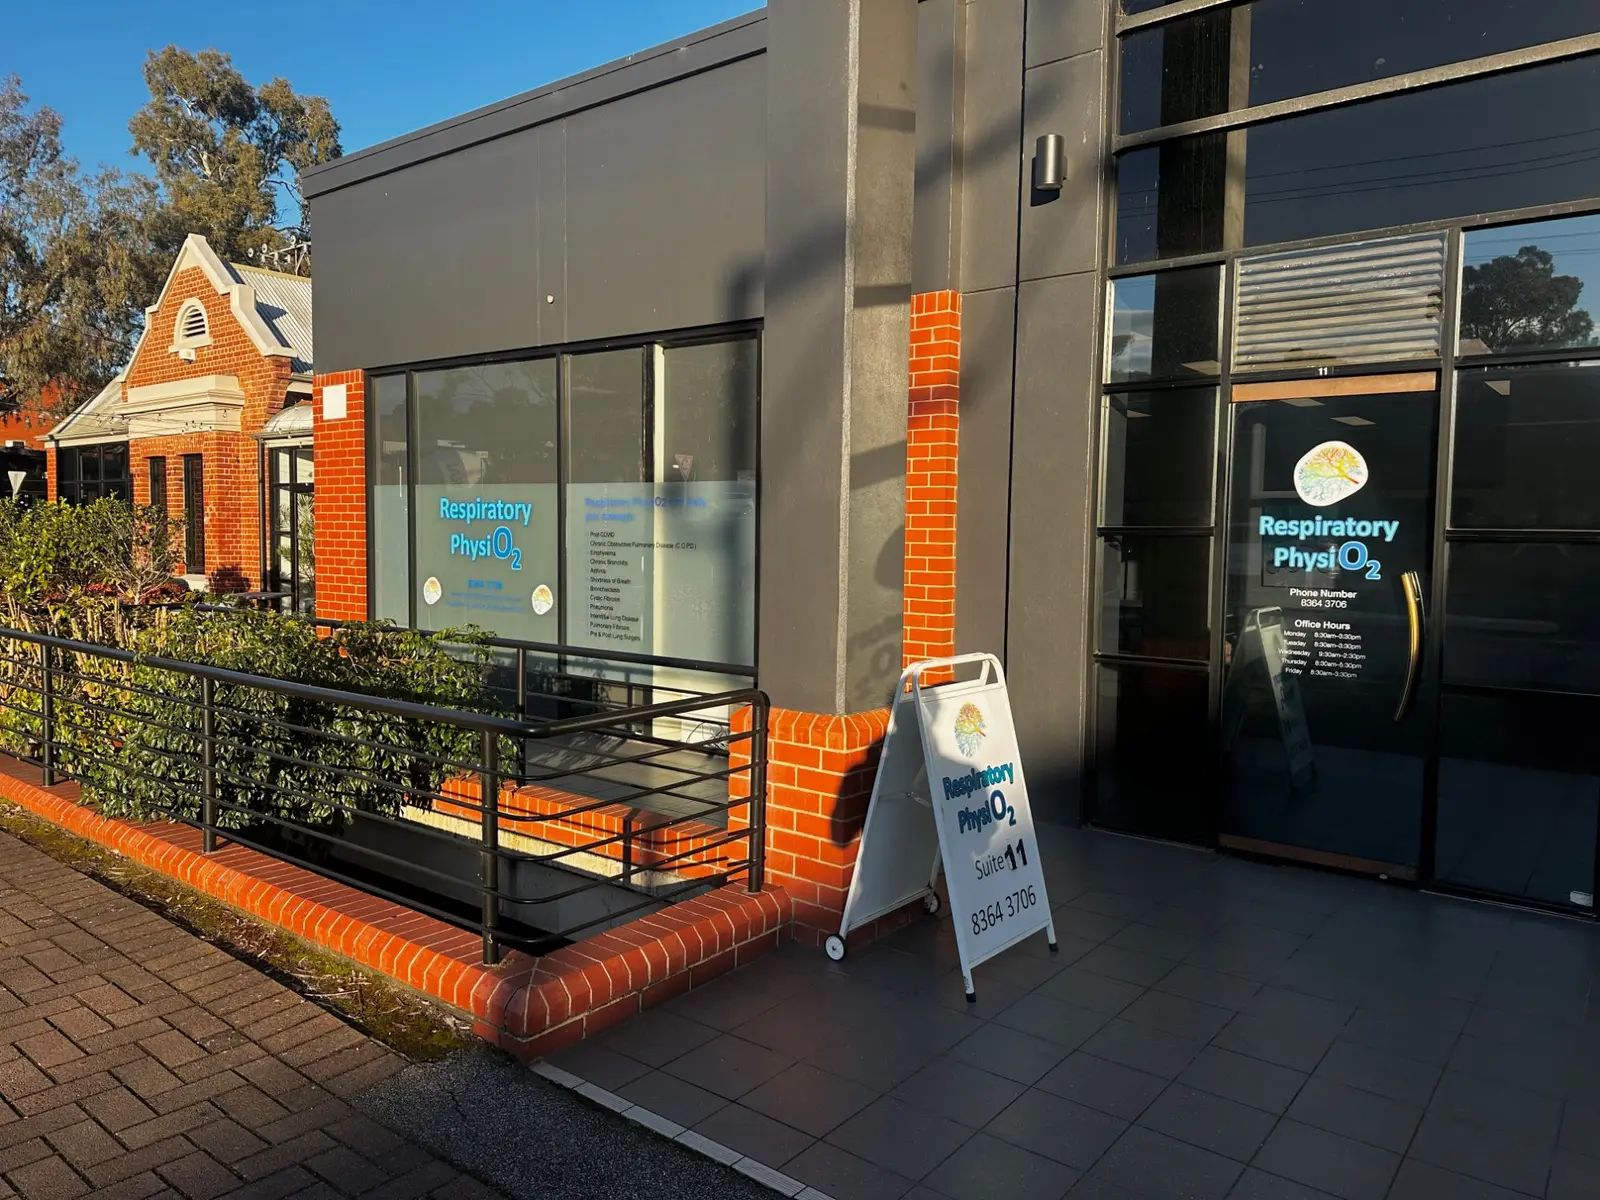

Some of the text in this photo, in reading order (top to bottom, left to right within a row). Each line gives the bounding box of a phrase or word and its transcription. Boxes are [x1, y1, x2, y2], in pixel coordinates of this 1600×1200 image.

[1318, 367, 1328, 376] 11
[440, 497, 532, 526] Respiratory
[1259, 515, 1400, 542] Respiratory
[590, 594, 603, 602] Cystic
[1290, 588, 1358, 599] Phone Number
[1301, 598, 1347, 608] 8364 3706
[1294, 619, 1351, 630] Office Hours
[1283, 629, 1307, 638] Monday
[1283, 639, 1307, 647] Tuesday
[1278, 648, 1311, 657] Wednesday
[1281, 657, 1307, 667] Thursday
[1285, 667, 1303, 675] Friday
[942, 762, 1014, 800] Respiratory
[974, 838, 1028, 880] Suite 11
[971, 885, 1037, 936] 8364 3706
